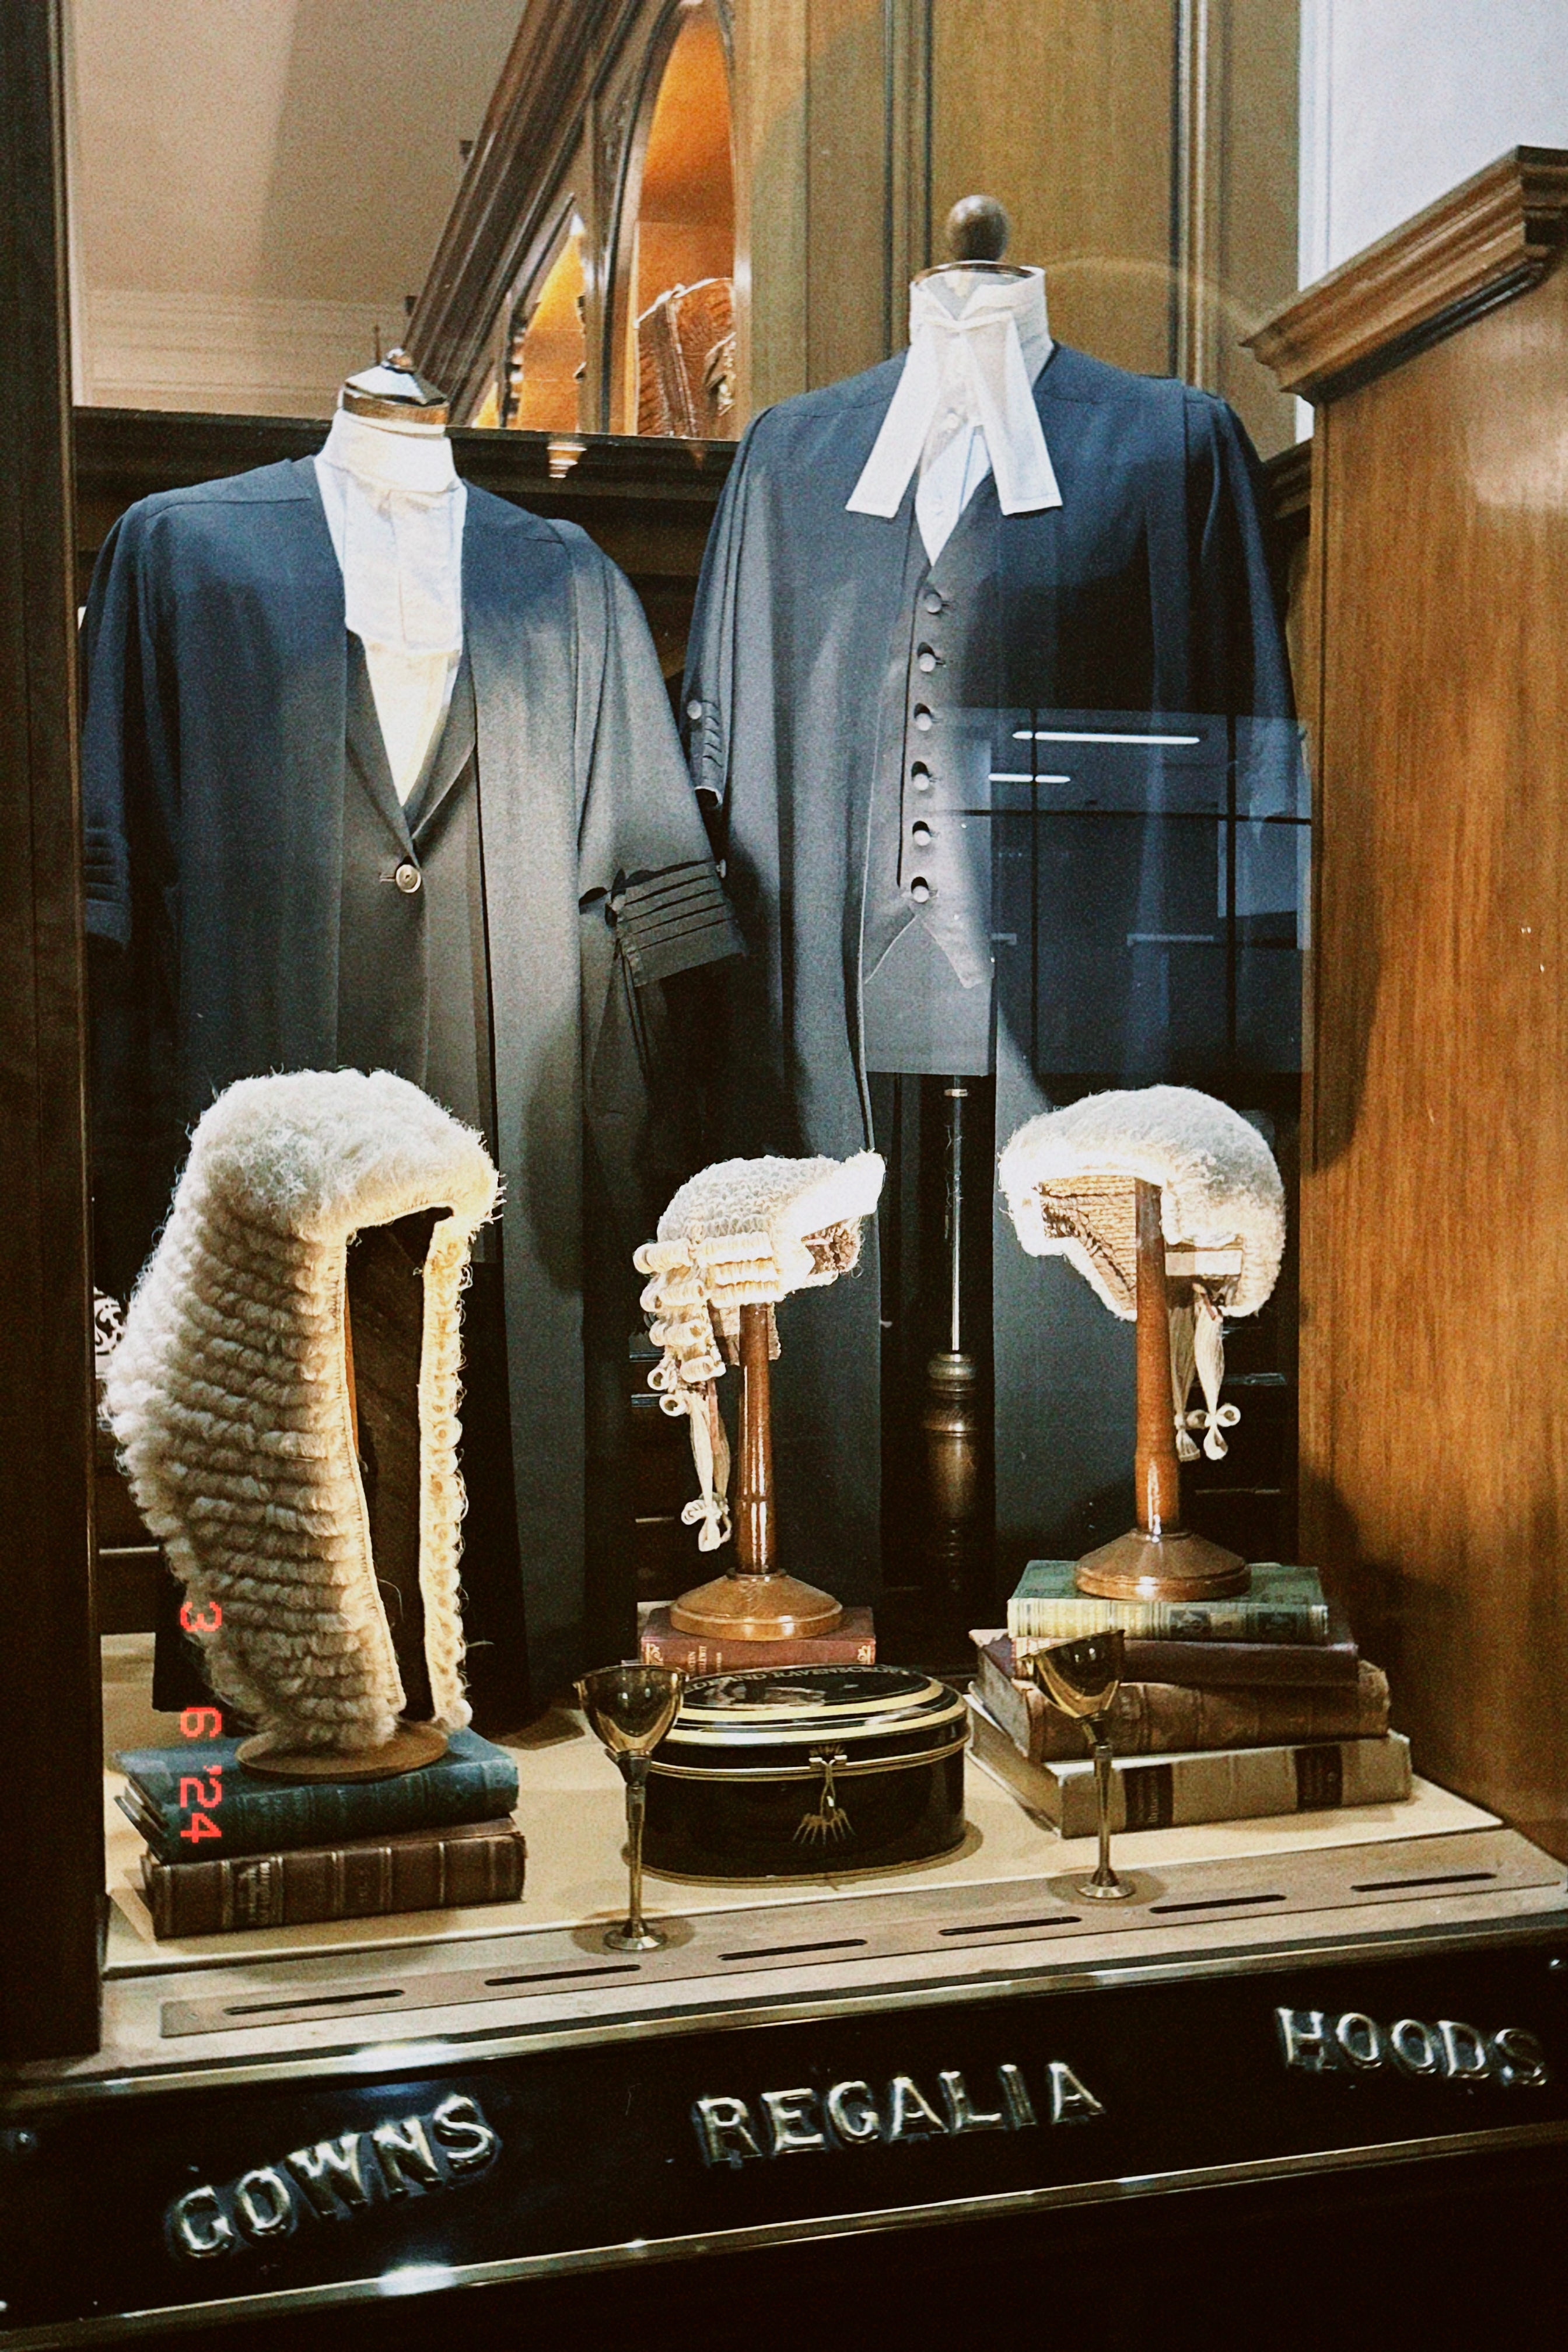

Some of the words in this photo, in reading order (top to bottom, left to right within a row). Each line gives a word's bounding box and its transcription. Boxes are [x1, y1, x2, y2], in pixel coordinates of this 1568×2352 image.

[1276, 2007, 1547, 2087] HOODS
[695, 2059, 1105, 2166] REGALIA
[175, 2094, 496, 2258] GOWNS
